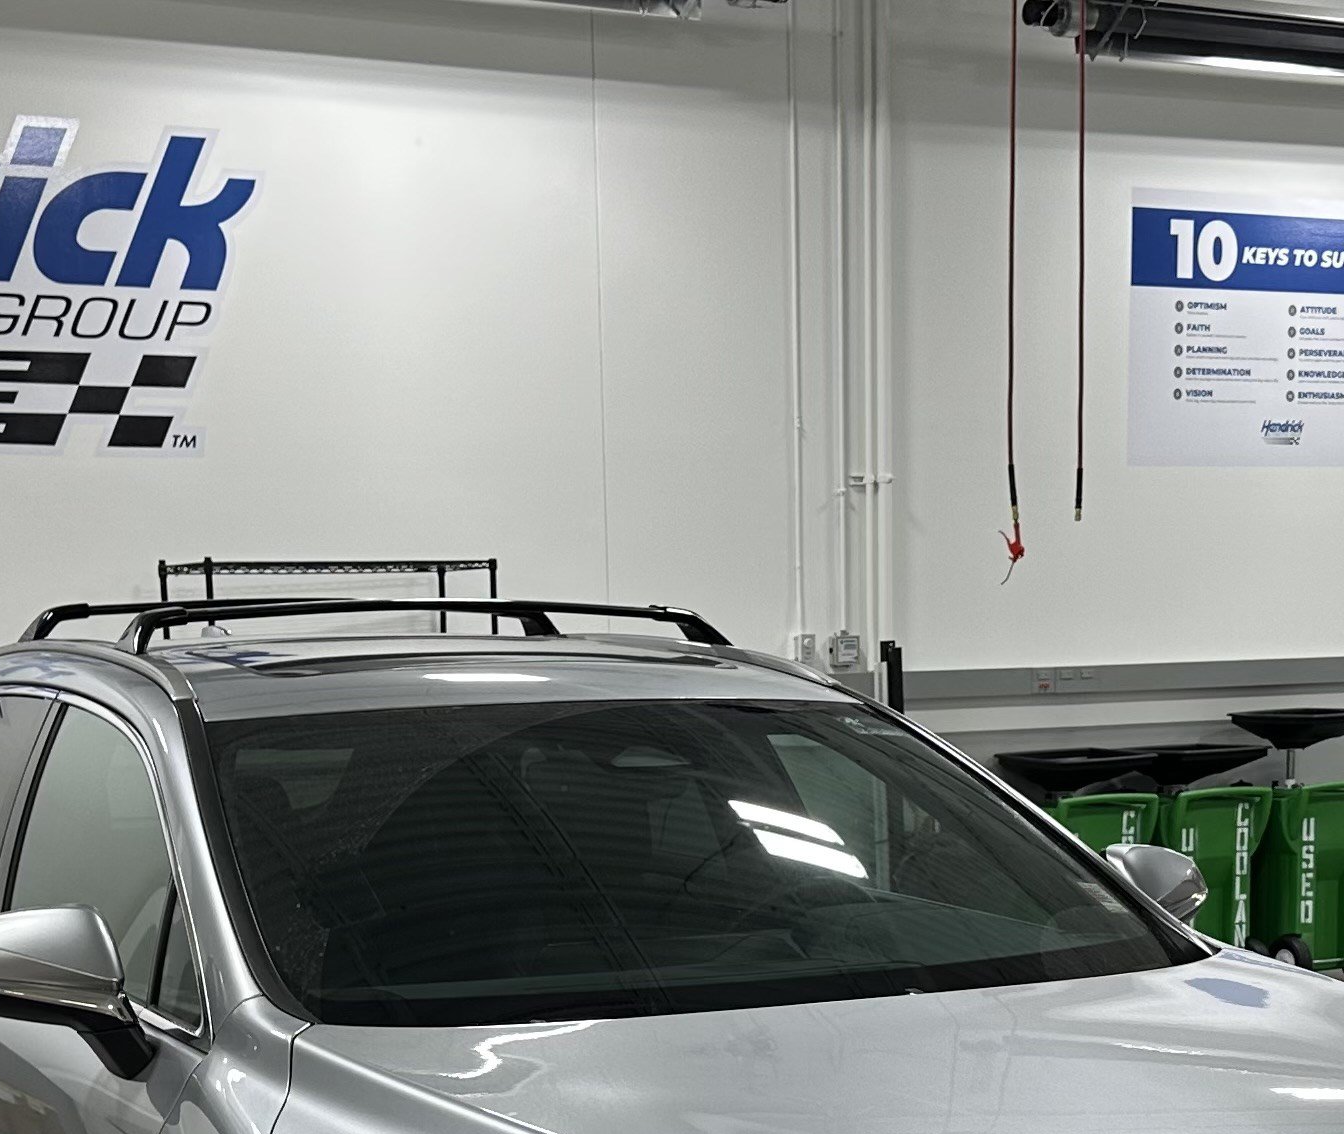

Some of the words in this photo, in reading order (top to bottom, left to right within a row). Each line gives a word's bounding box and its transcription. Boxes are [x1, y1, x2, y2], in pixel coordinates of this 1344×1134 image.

[1169, 218, 1239, 282] 10
[1242, 246, 1290, 266] KEYS
[1293, 249, 1318, 268] TO
[1187, 301, 1227, 310] OPTIMISM
[1300, 306, 1337, 314] ATTITUDE
[1186, 323, 1211, 332] FAITH
[1299, 327, 1325, 336] GOALS
[1186, 345, 1228, 354] PLANNING
[1185, 368, 1251, 377] DETERMINATION
[1185, 389, 1213, 397] VISION
[1260, 419, 1304, 437] Hendrick
[172, 434, 197, 449] TM
[1234, 802, 1250, 948] COOLAN
[1300, 817, 1315, 924] USED
